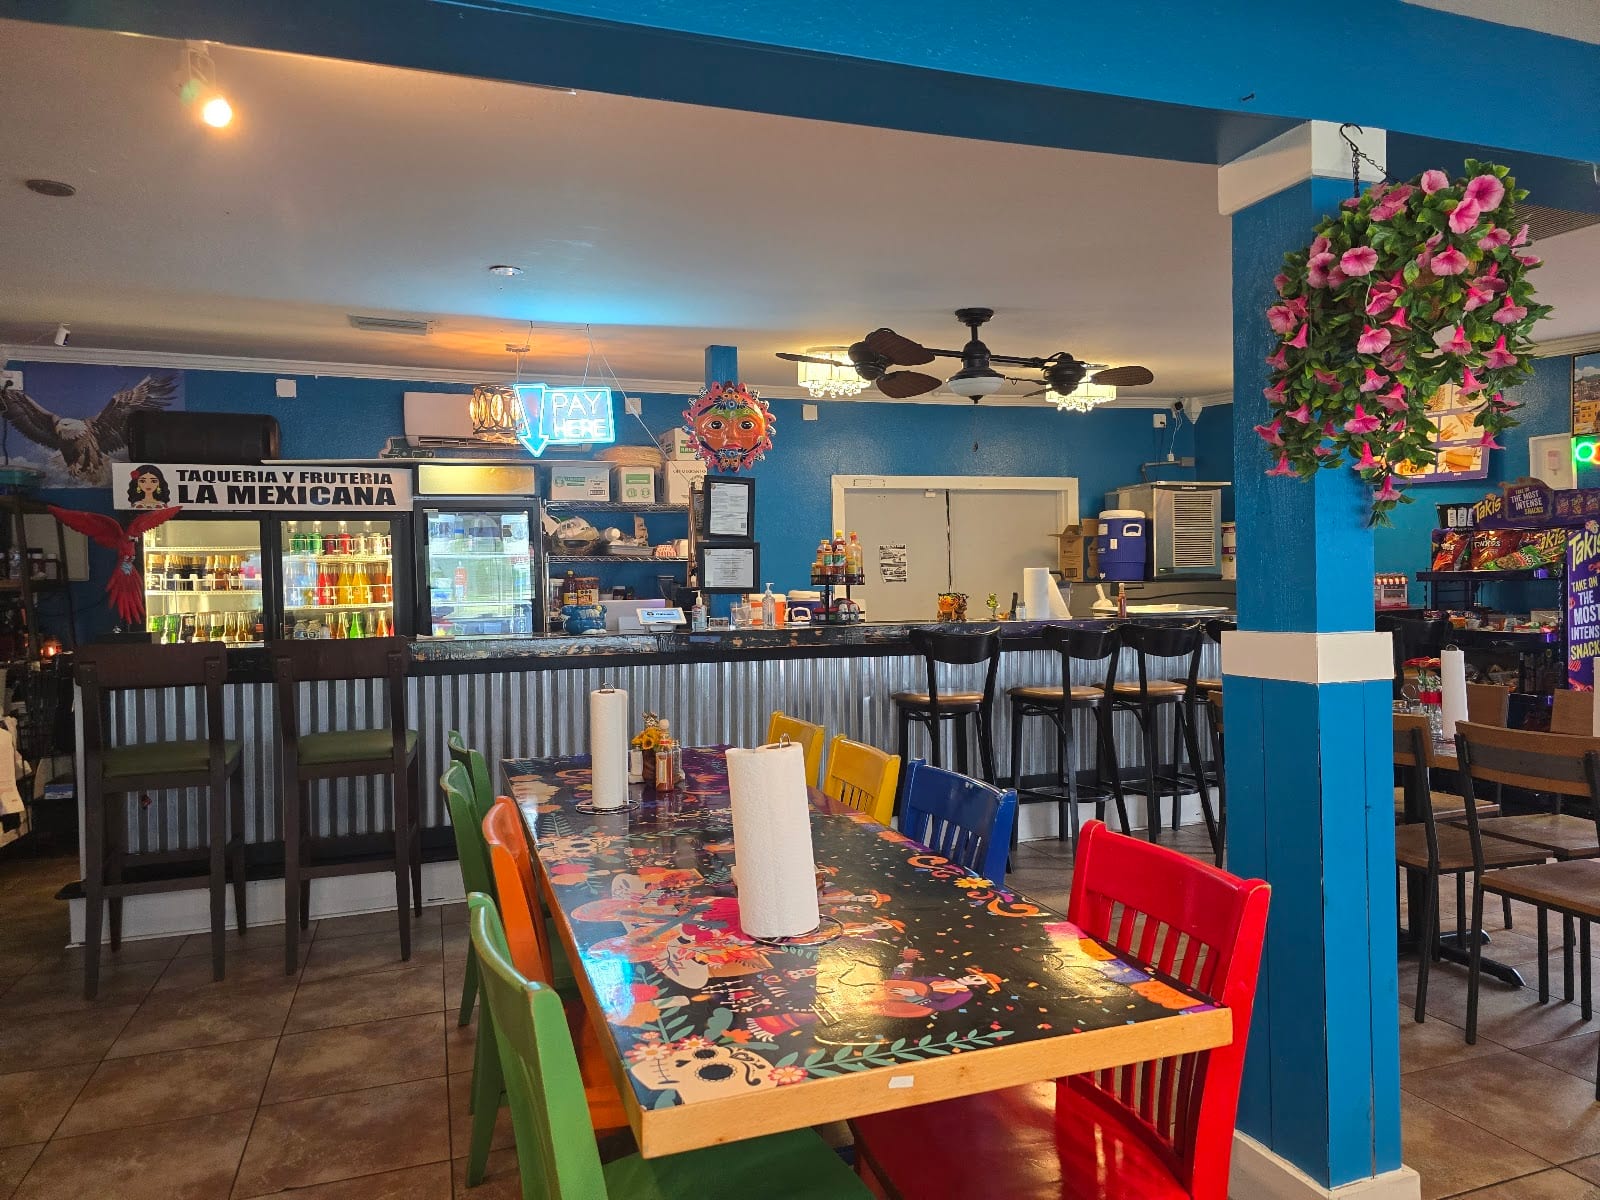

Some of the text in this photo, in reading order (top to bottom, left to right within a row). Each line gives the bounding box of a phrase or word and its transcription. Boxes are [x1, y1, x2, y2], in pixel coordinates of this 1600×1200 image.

[552, 393, 602, 416] PAY
[176, 470, 393, 484] TAQUERIA Y FRUTERIA
[178, 485, 396, 505] LA MEXICANA
[1510, 495, 1523, 503] THE
[1522, 490, 1539, 500] MOST
[1515, 498, 1543, 510] INTENSE
[1571, 576, 1598, 592] TAKE ON
[1578, 590, 1594, 605] THE
[1574, 604, 1600, 625] MOST
